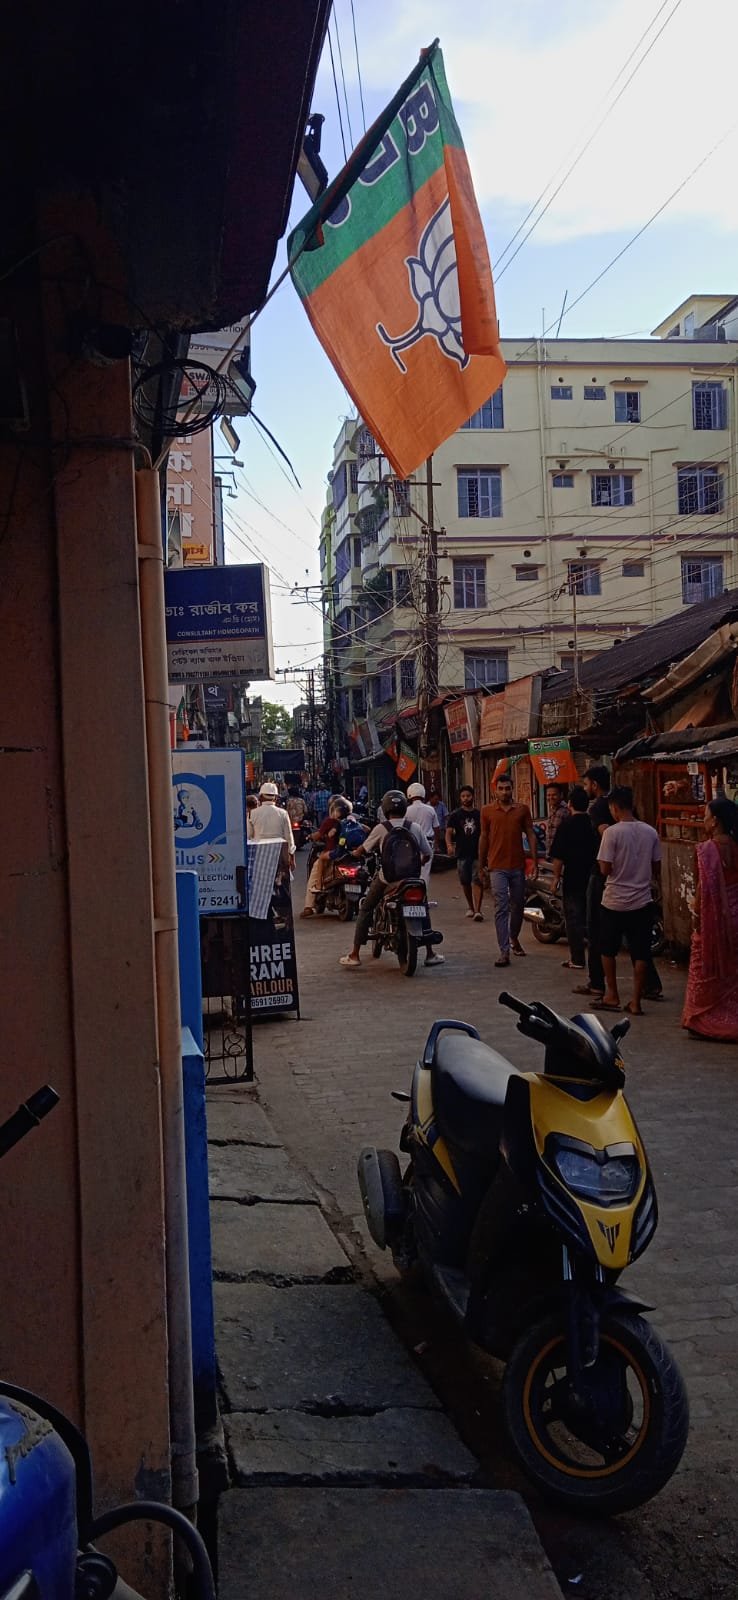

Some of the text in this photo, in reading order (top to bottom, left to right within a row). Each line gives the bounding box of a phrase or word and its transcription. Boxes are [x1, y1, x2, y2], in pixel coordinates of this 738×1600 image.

[325, 79, 440, 228] BJ
[188, 600, 232, 617] রাজীব
[234, 601, 258, 613] কর
[177, 629, 216, 637] CONSULTANT
[176, 850, 205, 865] ilus
[198, 873, 234, 882] LLECTION
[249, 943, 292, 963] HREE
[250, 961, 285, 981] RAM
[250, 979, 293, 997] ARLOUR
